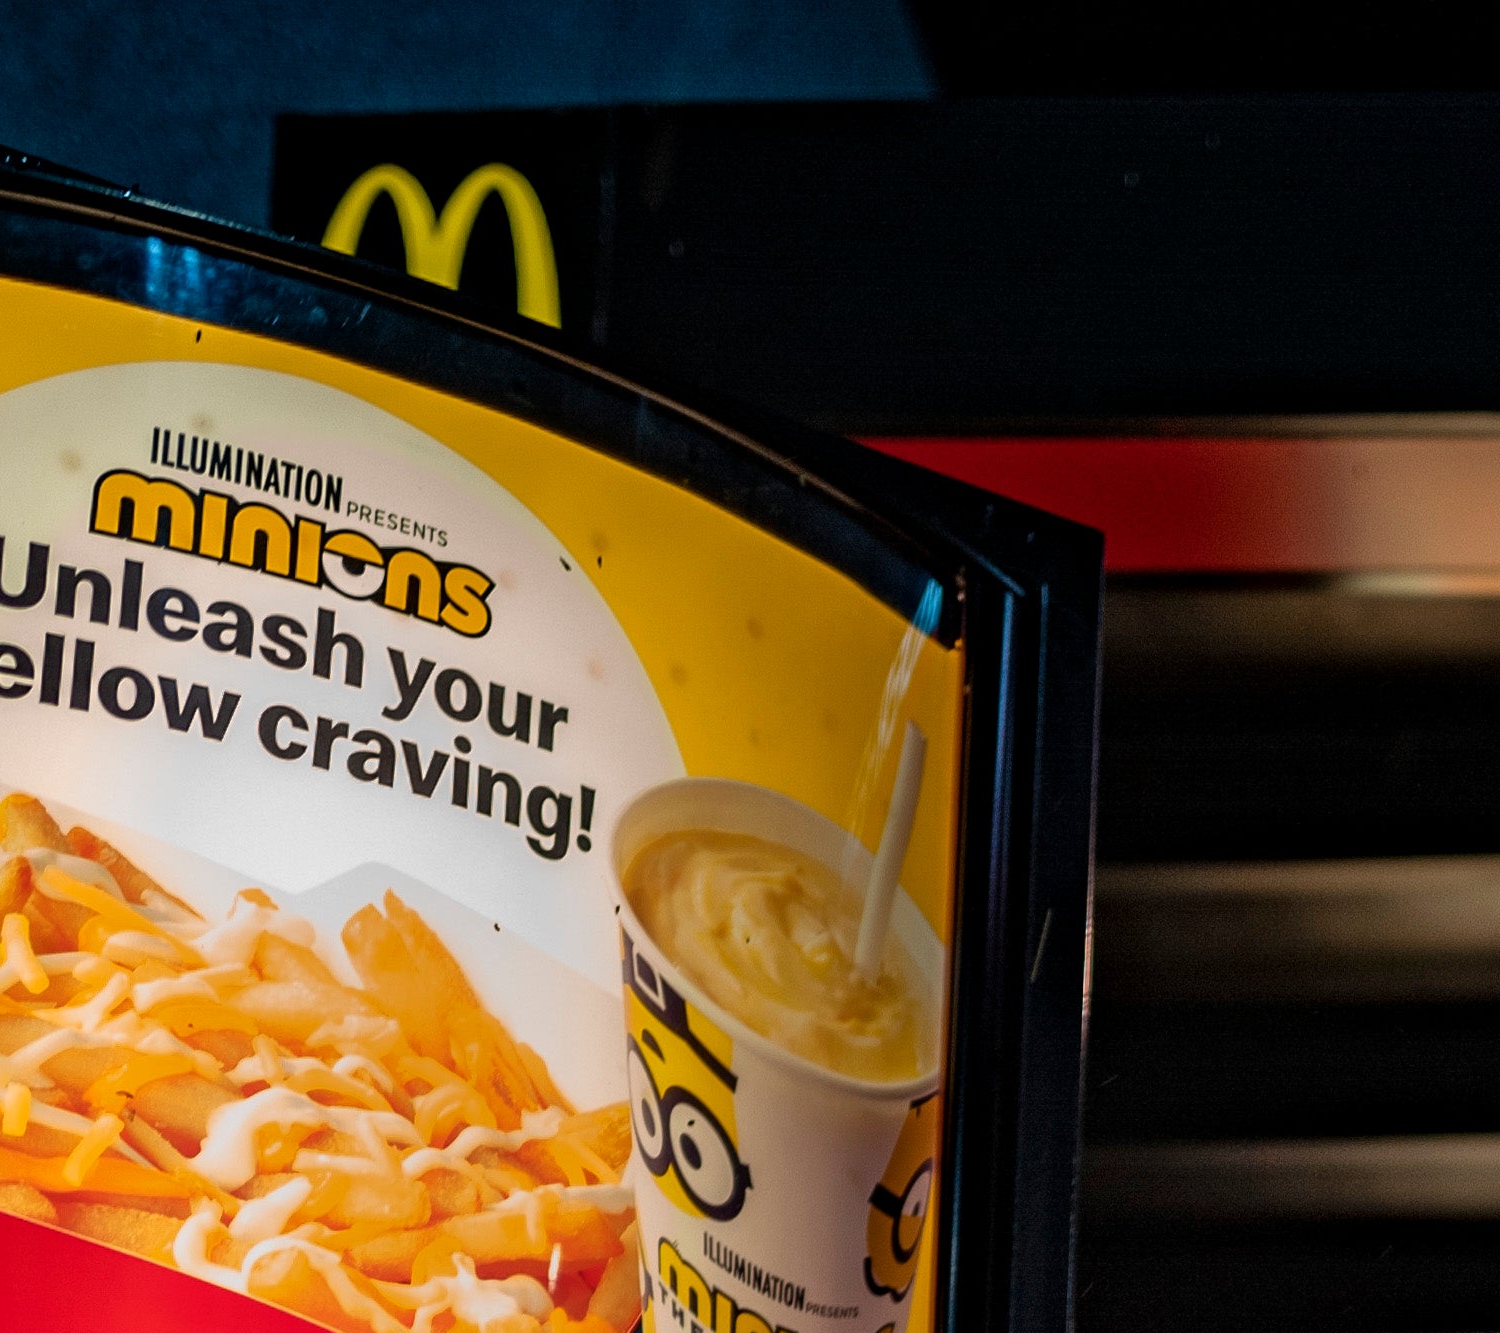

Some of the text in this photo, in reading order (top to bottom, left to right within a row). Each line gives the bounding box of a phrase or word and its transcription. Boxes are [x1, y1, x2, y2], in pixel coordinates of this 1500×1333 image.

[151, 426, 448, 547] ILLUMINATION PRESENTS
[382, 647, 569, 753] your
[258, 701, 596, 862] craving!
[703, 1231, 805, 1311] ILLUMINATION
